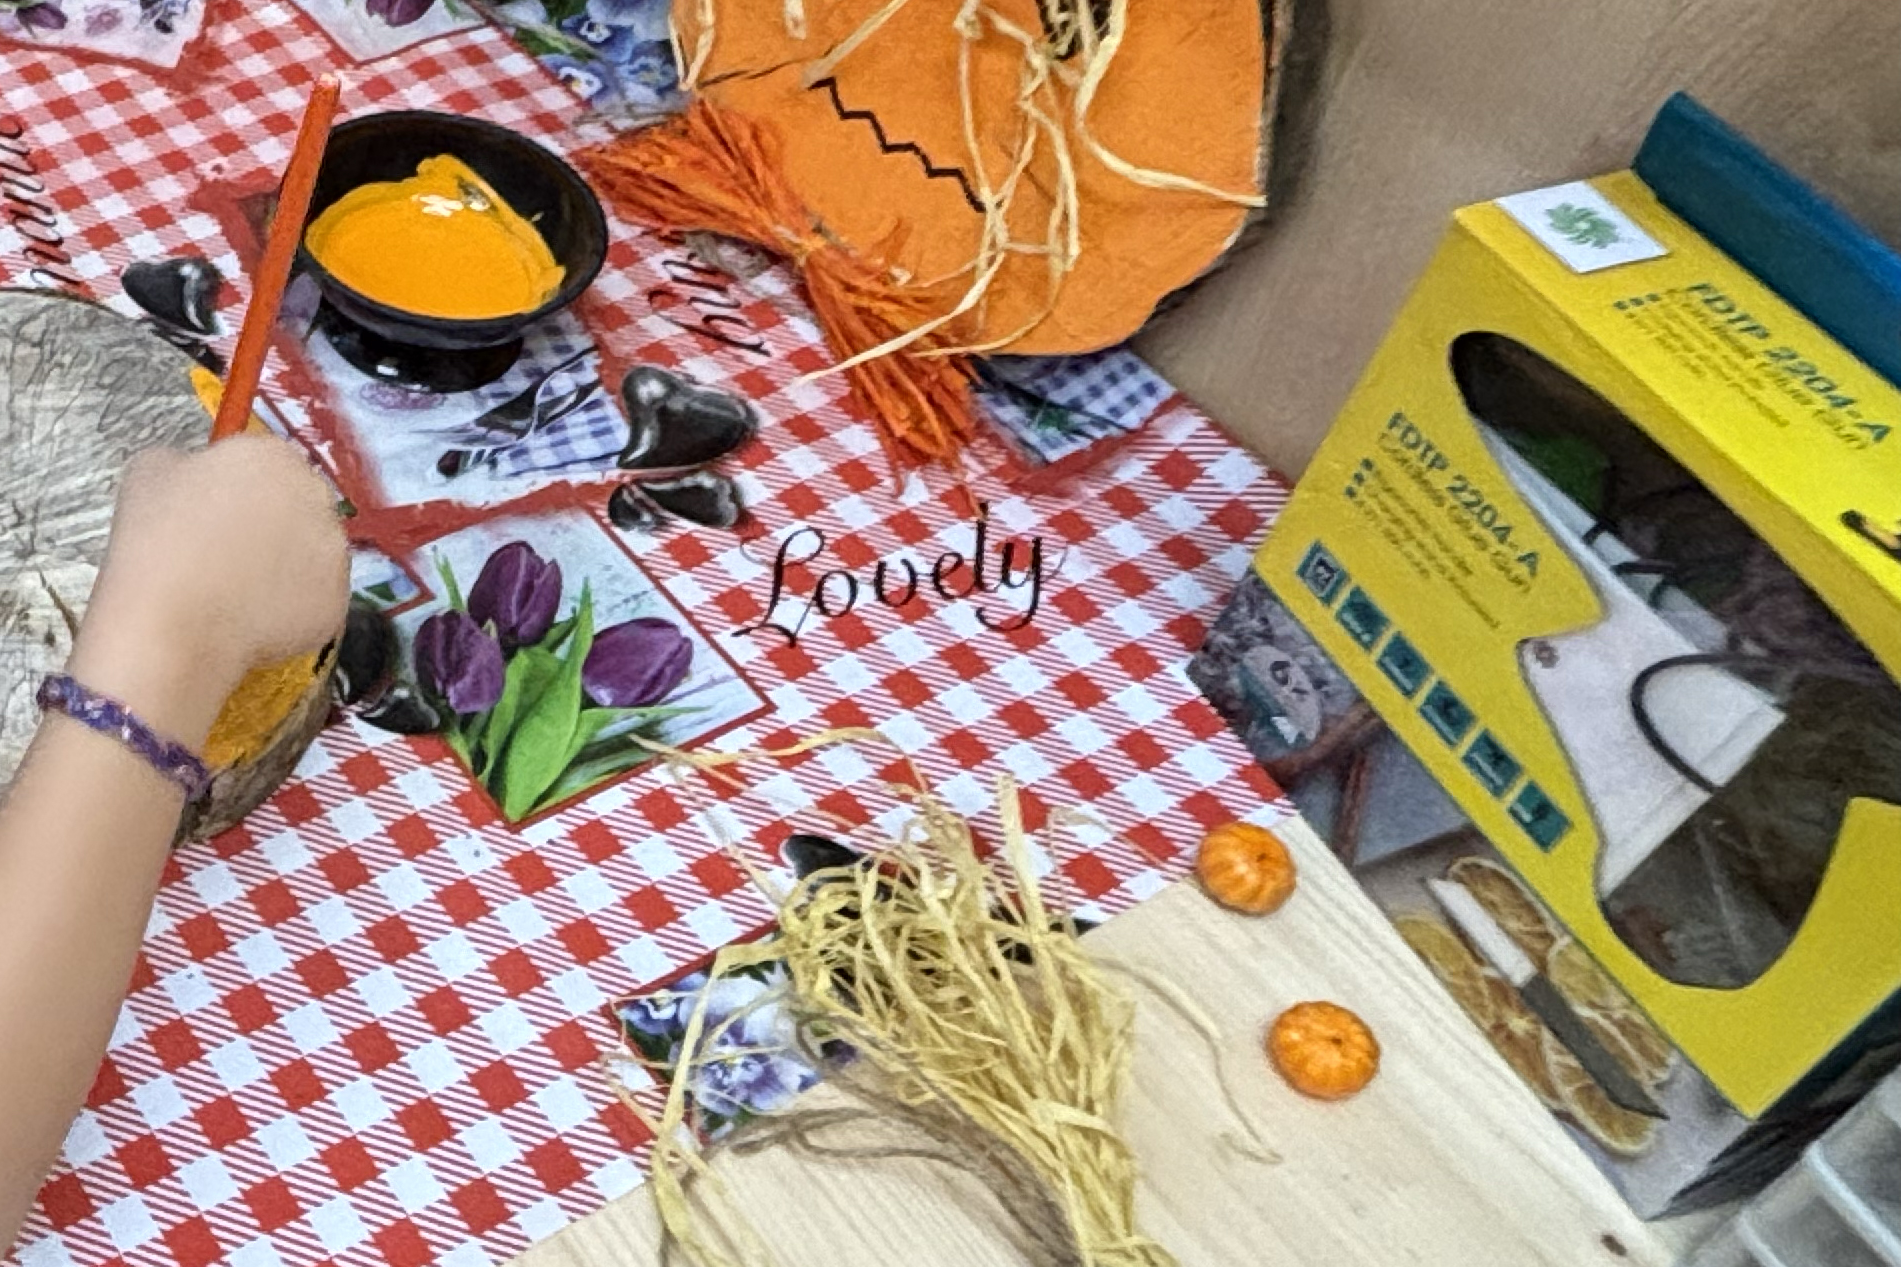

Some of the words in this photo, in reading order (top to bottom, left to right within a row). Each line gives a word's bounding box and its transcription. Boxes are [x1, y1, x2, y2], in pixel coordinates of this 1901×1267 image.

[1686, 283, 1771, 340] FDTP
[1763, 346, 1894, 444] 2204-A
[732, 501, 1068, 648] Lovely
[1387, 411, 1450, 471] FDTP
[1445, 474, 1540, 578] 2204-A
